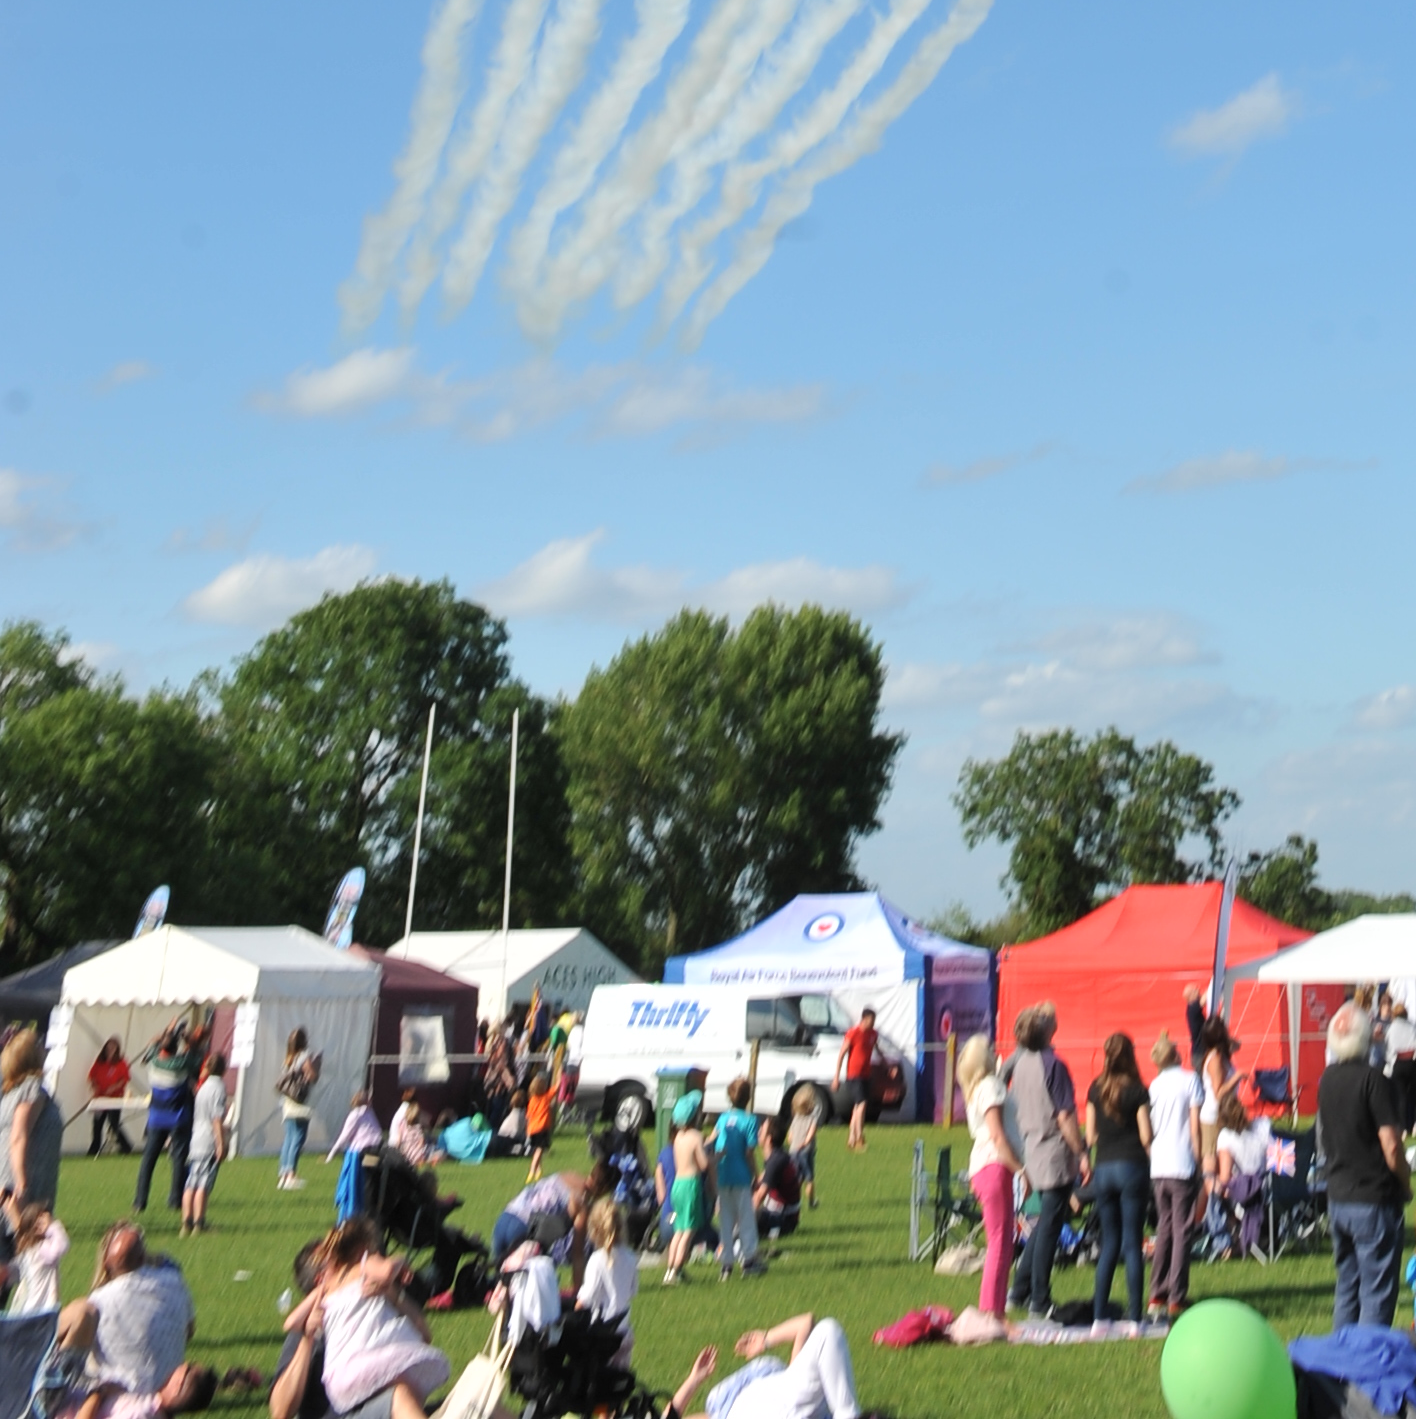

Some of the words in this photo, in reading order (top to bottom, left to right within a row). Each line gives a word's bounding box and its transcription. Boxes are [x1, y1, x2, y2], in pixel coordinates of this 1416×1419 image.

[542, 964, 578, 990] ACES
[582, 964, 617, 988] HIGH
[710, 967, 741, 985] Royal
[627, 999, 711, 1039] Thrifty
